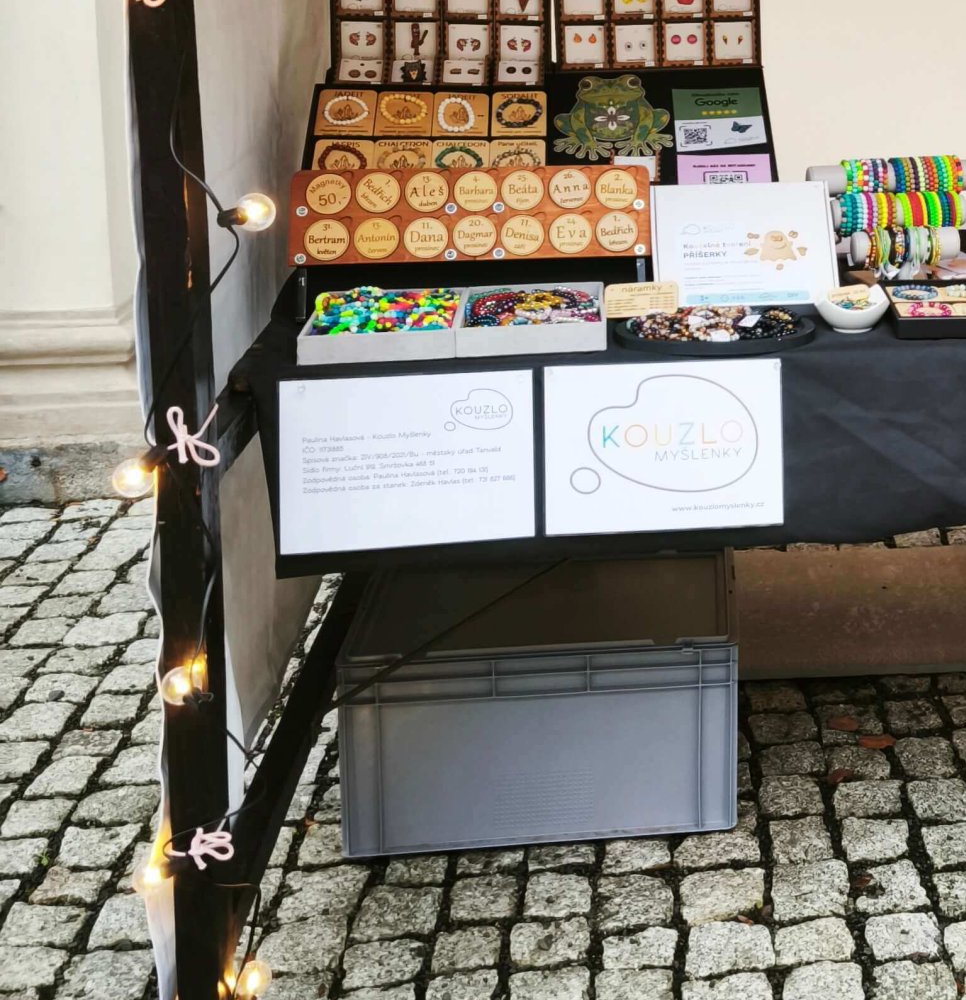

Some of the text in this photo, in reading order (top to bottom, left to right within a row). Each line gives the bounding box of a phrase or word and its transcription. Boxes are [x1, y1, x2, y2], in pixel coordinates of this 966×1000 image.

[694, 97, 738, 108] Google
[309, 178, 346, 194] Magnetky
[410, 184, 444, 198] Aleš
[458, 186, 494, 196] Barbara
[508, 183, 538, 195] Beáta
[552, 182, 590, 194] Anna
[600, 183, 634, 196] Blanka
[421, 222, 433, 230] 11.
[468, 219, 484, 227] 20.
[410, 230, 444, 244] Dana
[457, 230, 494, 242] Dagmar
[504, 227, 540, 242] Denisa
[556, 226, 587, 239] Eva
[600, 225, 634, 237] Bedřich
[308, 235, 346, 244] Bertram
[357, 234, 396, 244] Antonín
[455, 404, 508, 416] KOUZLO
[602, 419, 744, 448] KOUZLO
[654, 446, 742, 462] MYŠLENKY
